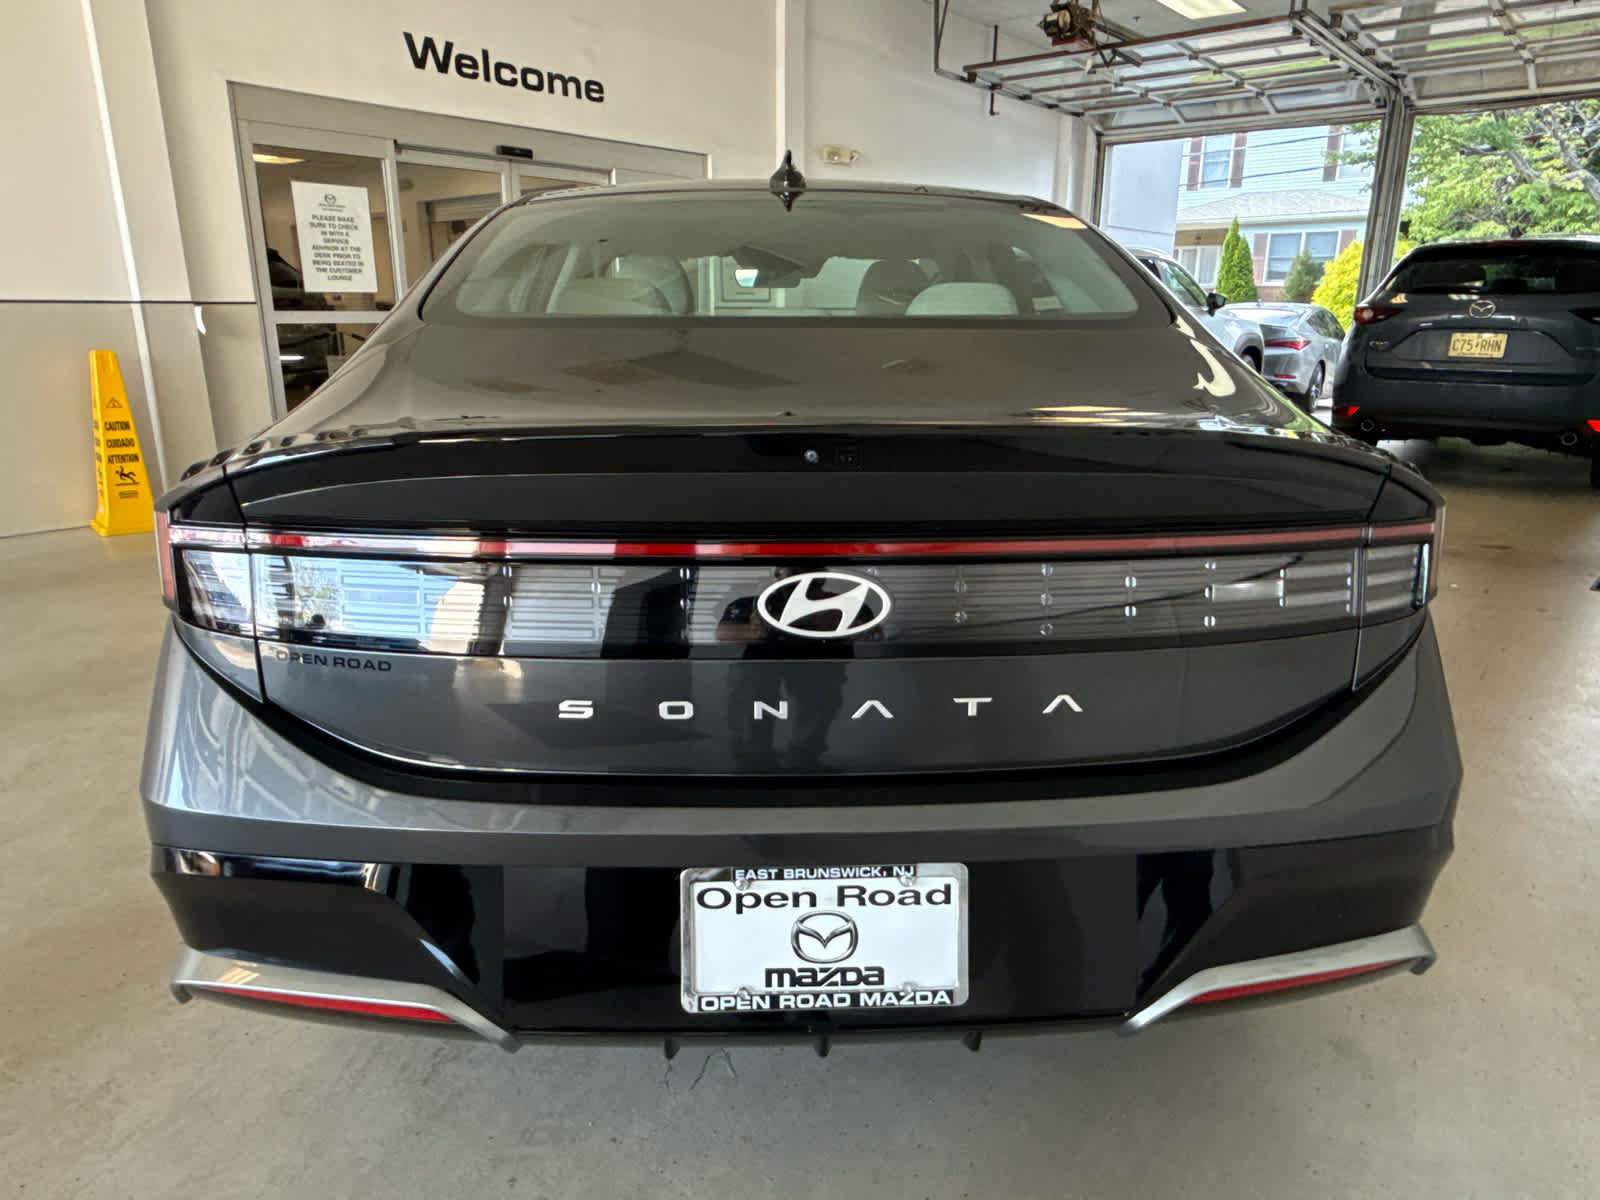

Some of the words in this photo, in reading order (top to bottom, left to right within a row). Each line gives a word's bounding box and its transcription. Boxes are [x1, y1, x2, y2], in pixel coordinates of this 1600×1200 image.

[403, 31, 605, 103] Welcome
[311, 214, 336, 222] PLEASE
[338, 223, 358, 231] CHECK
[104, 420, 131, 431] CAUTION
[106, 438, 135, 448] CUIDADO
[107, 453, 140, 464] ATTENTION
[276, 650, 327, 666] OPEN
[332, 655, 393, 672] ROAD
[734, 868, 778, 880] EAST
[892, 865, 916, 877] NJ
[696, 886, 818, 914] Open
[836, 883, 952, 908] Road
[765, 966, 885, 988] mazda
[700, 994, 771, 1011] OPEN
[778, 992, 851, 1010] ROAD
[859, 990, 951, 1007] MAZDA
